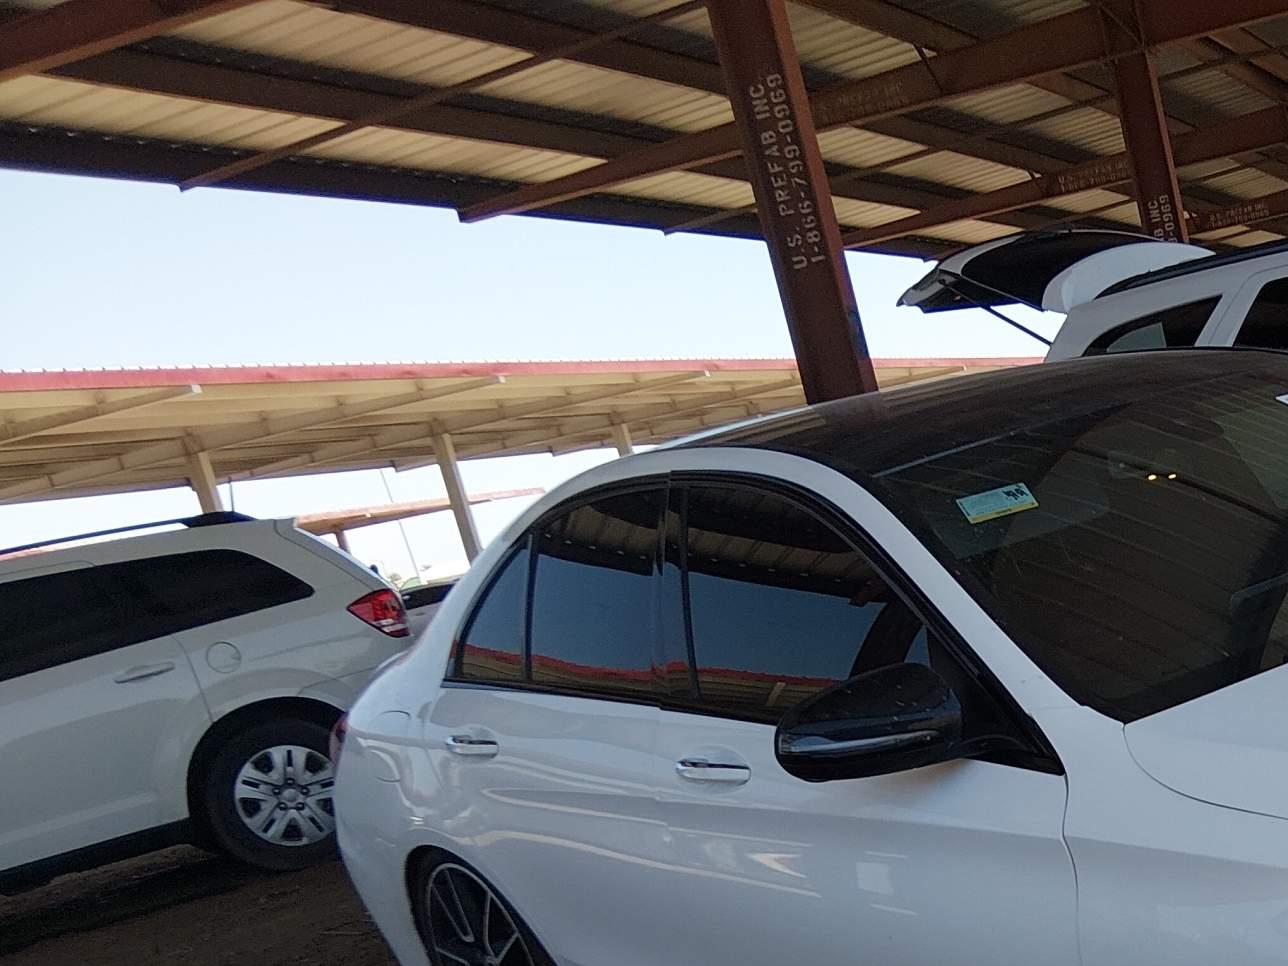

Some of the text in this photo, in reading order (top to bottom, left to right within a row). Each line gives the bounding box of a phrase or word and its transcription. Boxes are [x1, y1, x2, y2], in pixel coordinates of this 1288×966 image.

[749, 83, 771, 120] INC
[761, 130, 795, 216] PREFAB
[766, 73, 826, 263] 1-866-799-0969
[1148, 200, 1161, 223] INC
